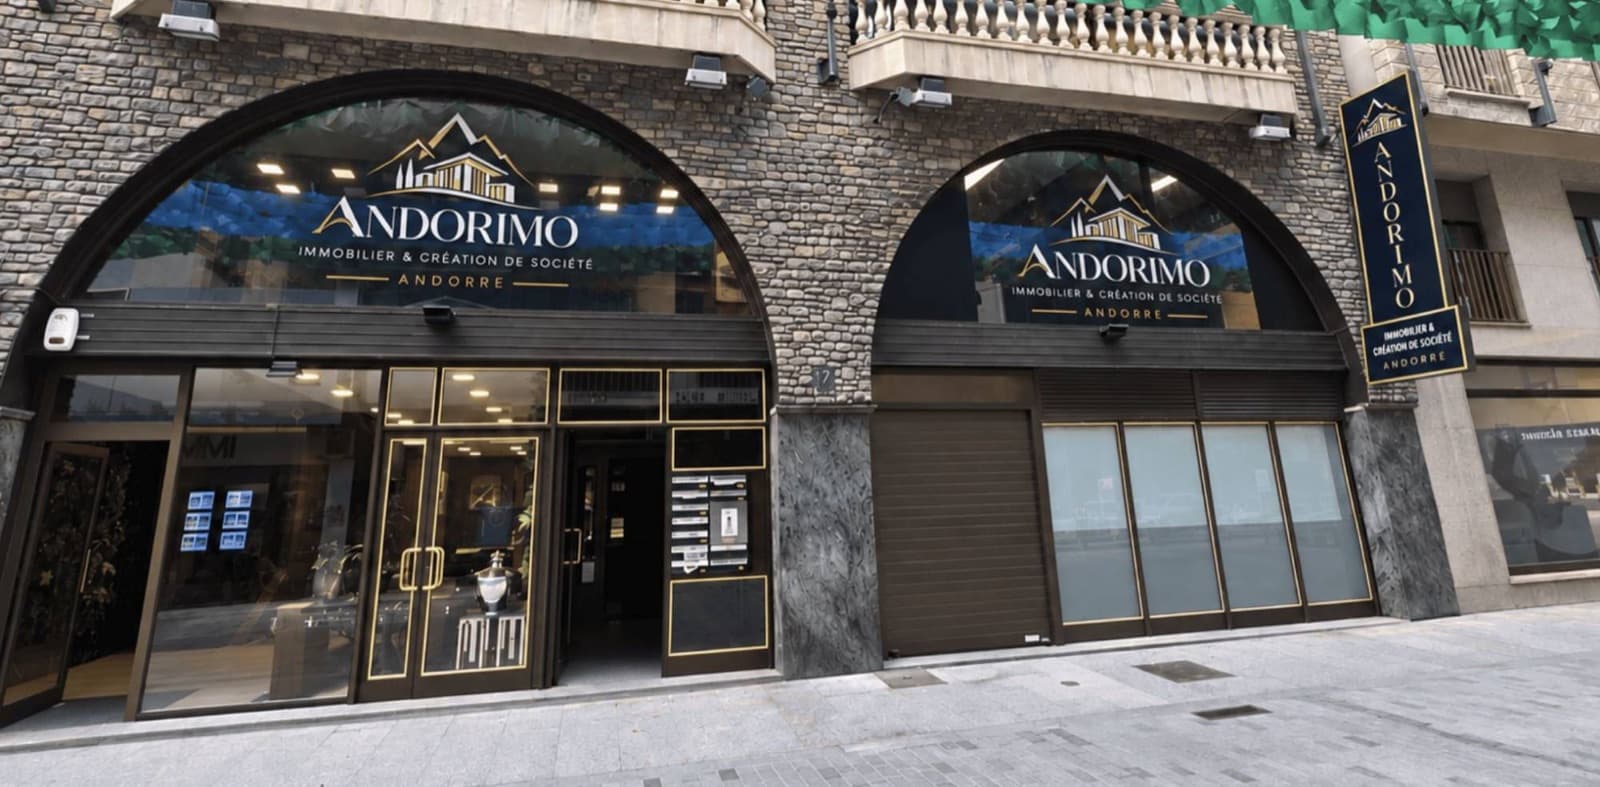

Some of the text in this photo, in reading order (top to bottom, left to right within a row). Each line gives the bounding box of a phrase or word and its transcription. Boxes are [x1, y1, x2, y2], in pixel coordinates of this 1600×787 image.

[312, 195, 579, 249] ANDORIMO
[1374, 141, 1415, 309] ANDORIMO
[298, 246, 593, 270] IMMOBILIER & CRÉATION DE SOCIÉTÉ
[1018, 243, 1211, 288] ANDORIMO
[398, 274, 503, 289] ANDORRE
[1011, 286, 1081, 298] IMMOBILIER
[1086, 289, 1094, 298] &
[1099, 288, 1154, 301] CRÉATION
[1159, 293, 1172, 302] DE
[1084, 307, 1161, 319] ANDORRE
[1384, 322, 1435, 340] IMMOBILIER &
[1373, 331, 1452, 356] CRÉATION DE SOCIÉTÉ
[1384, 352, 1446, 370] ANDORRE
